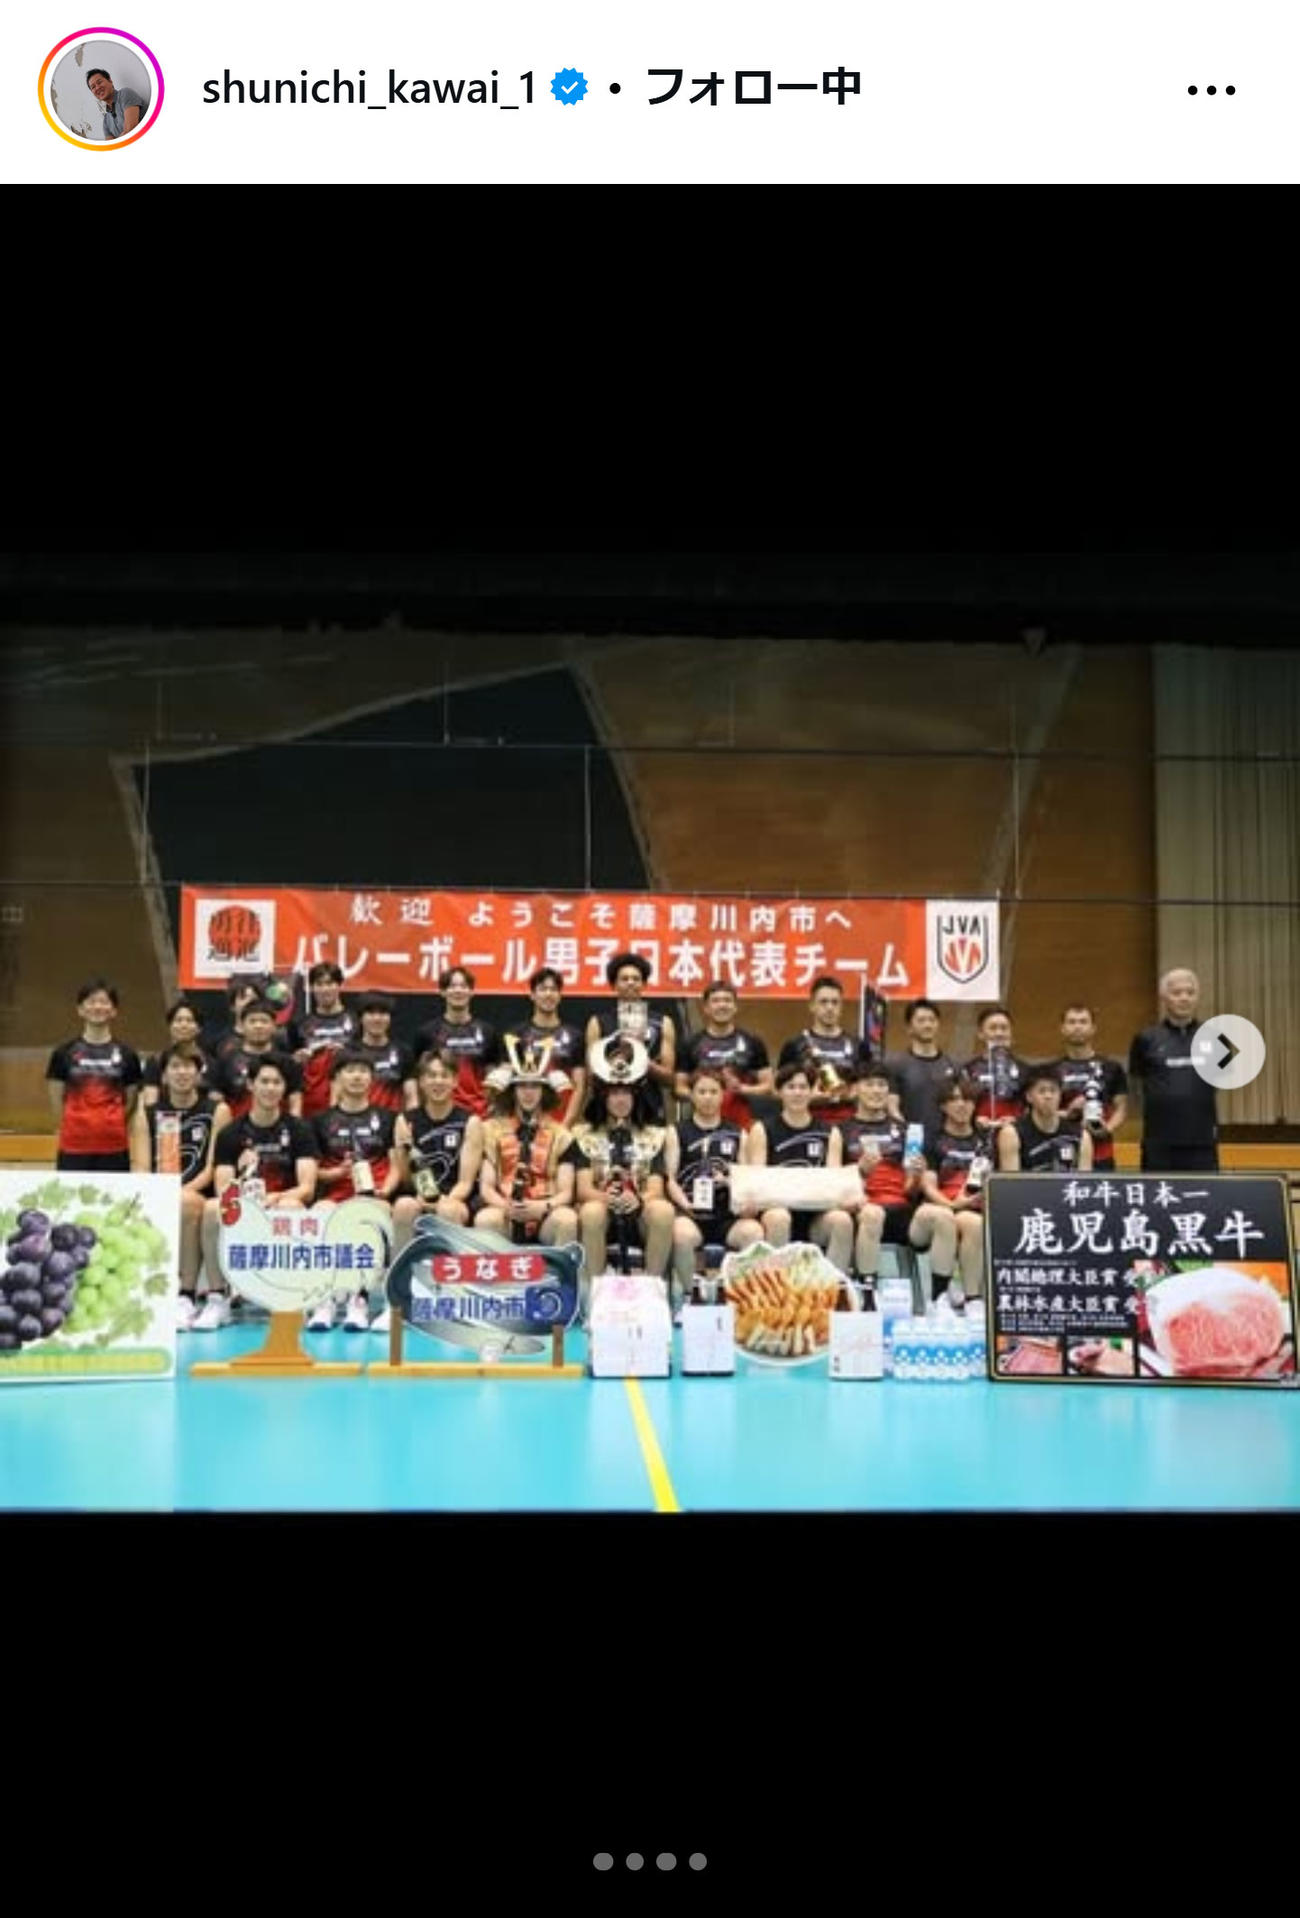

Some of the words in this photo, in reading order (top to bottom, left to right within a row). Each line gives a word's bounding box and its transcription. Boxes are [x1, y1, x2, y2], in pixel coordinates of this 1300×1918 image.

[942, 915, 981, 936] JVA
[1062, 1180, 1211, 1207] 和牛日本一
[1012, 1208, 1266, 1259] 鹿児島黒牛
[228, 1243, 375, 1269] 薩摩川内市議会
[442, 1256, 532, 1280] うなぎ
